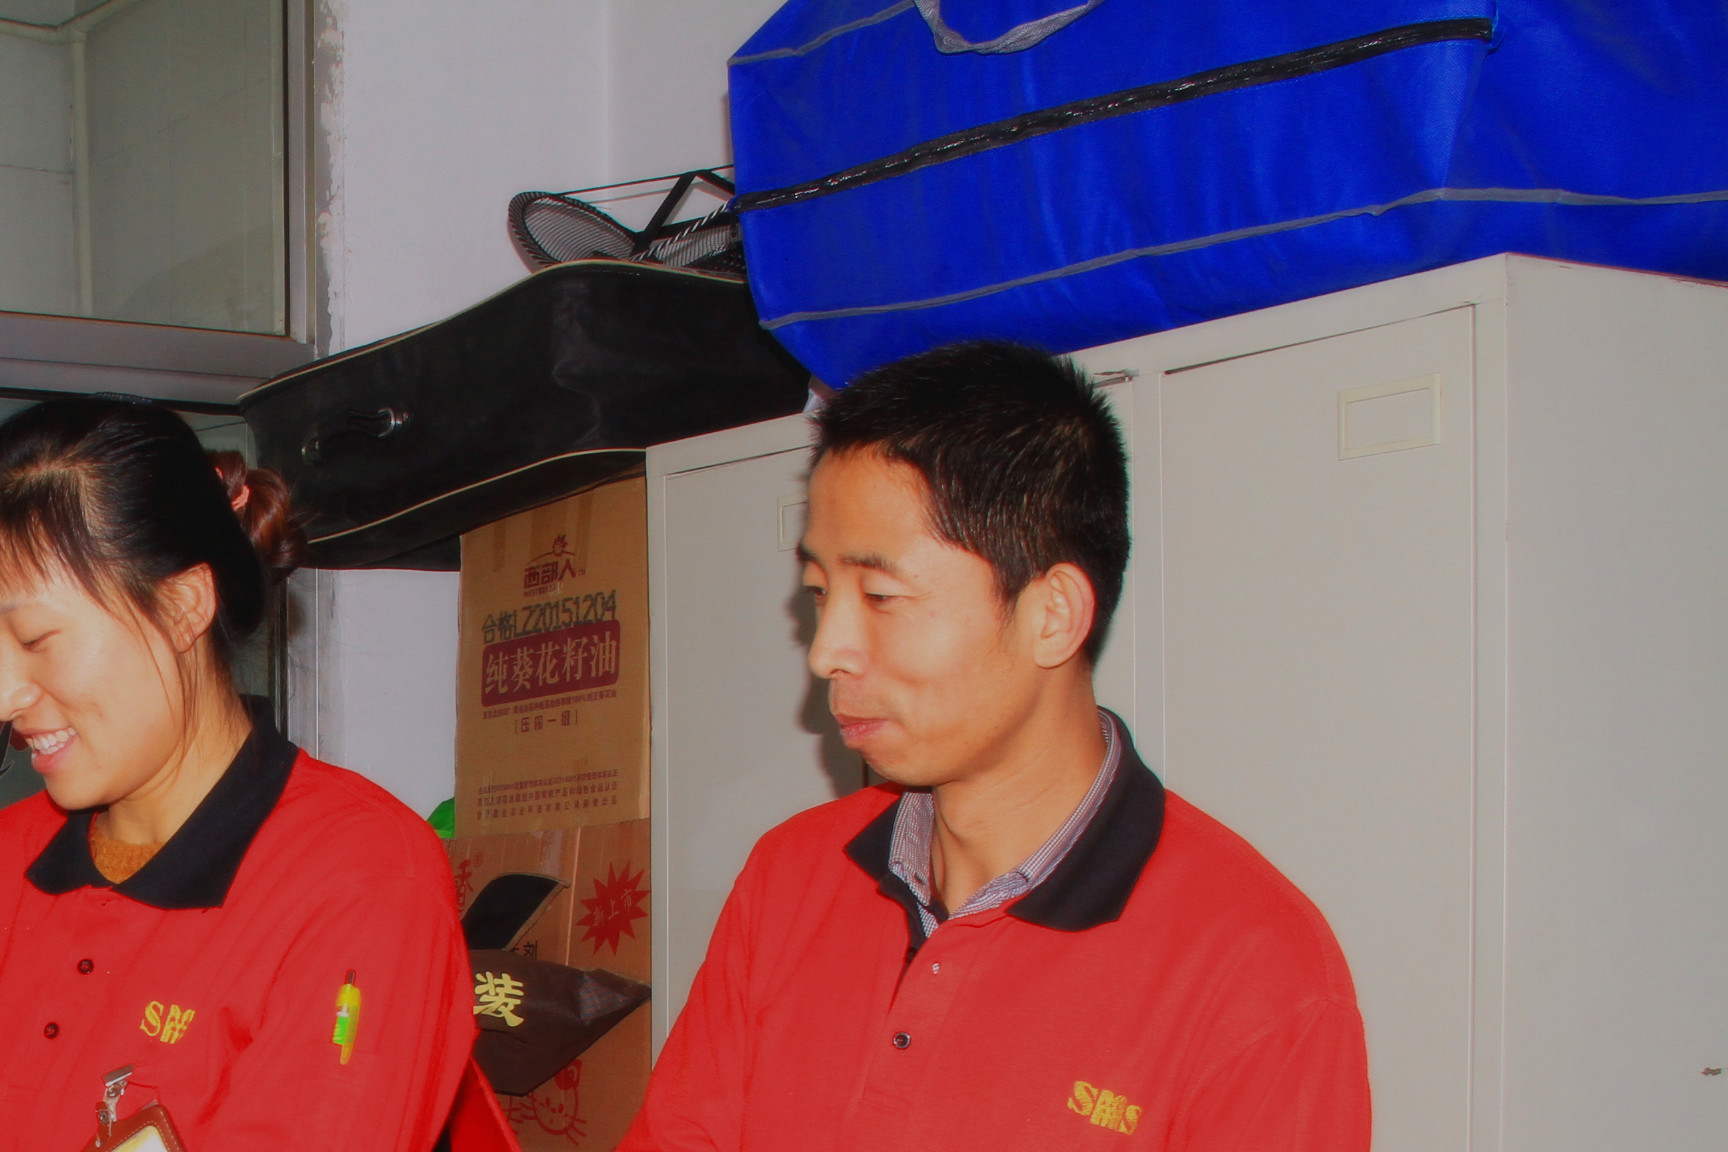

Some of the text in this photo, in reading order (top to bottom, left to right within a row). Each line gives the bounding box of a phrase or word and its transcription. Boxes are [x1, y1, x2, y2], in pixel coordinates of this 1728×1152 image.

[524, 558, 576, 590] 西部人
[485, 630, 617, 694] 纯葵花籽油
[473, 971, 524, 1027] 装
